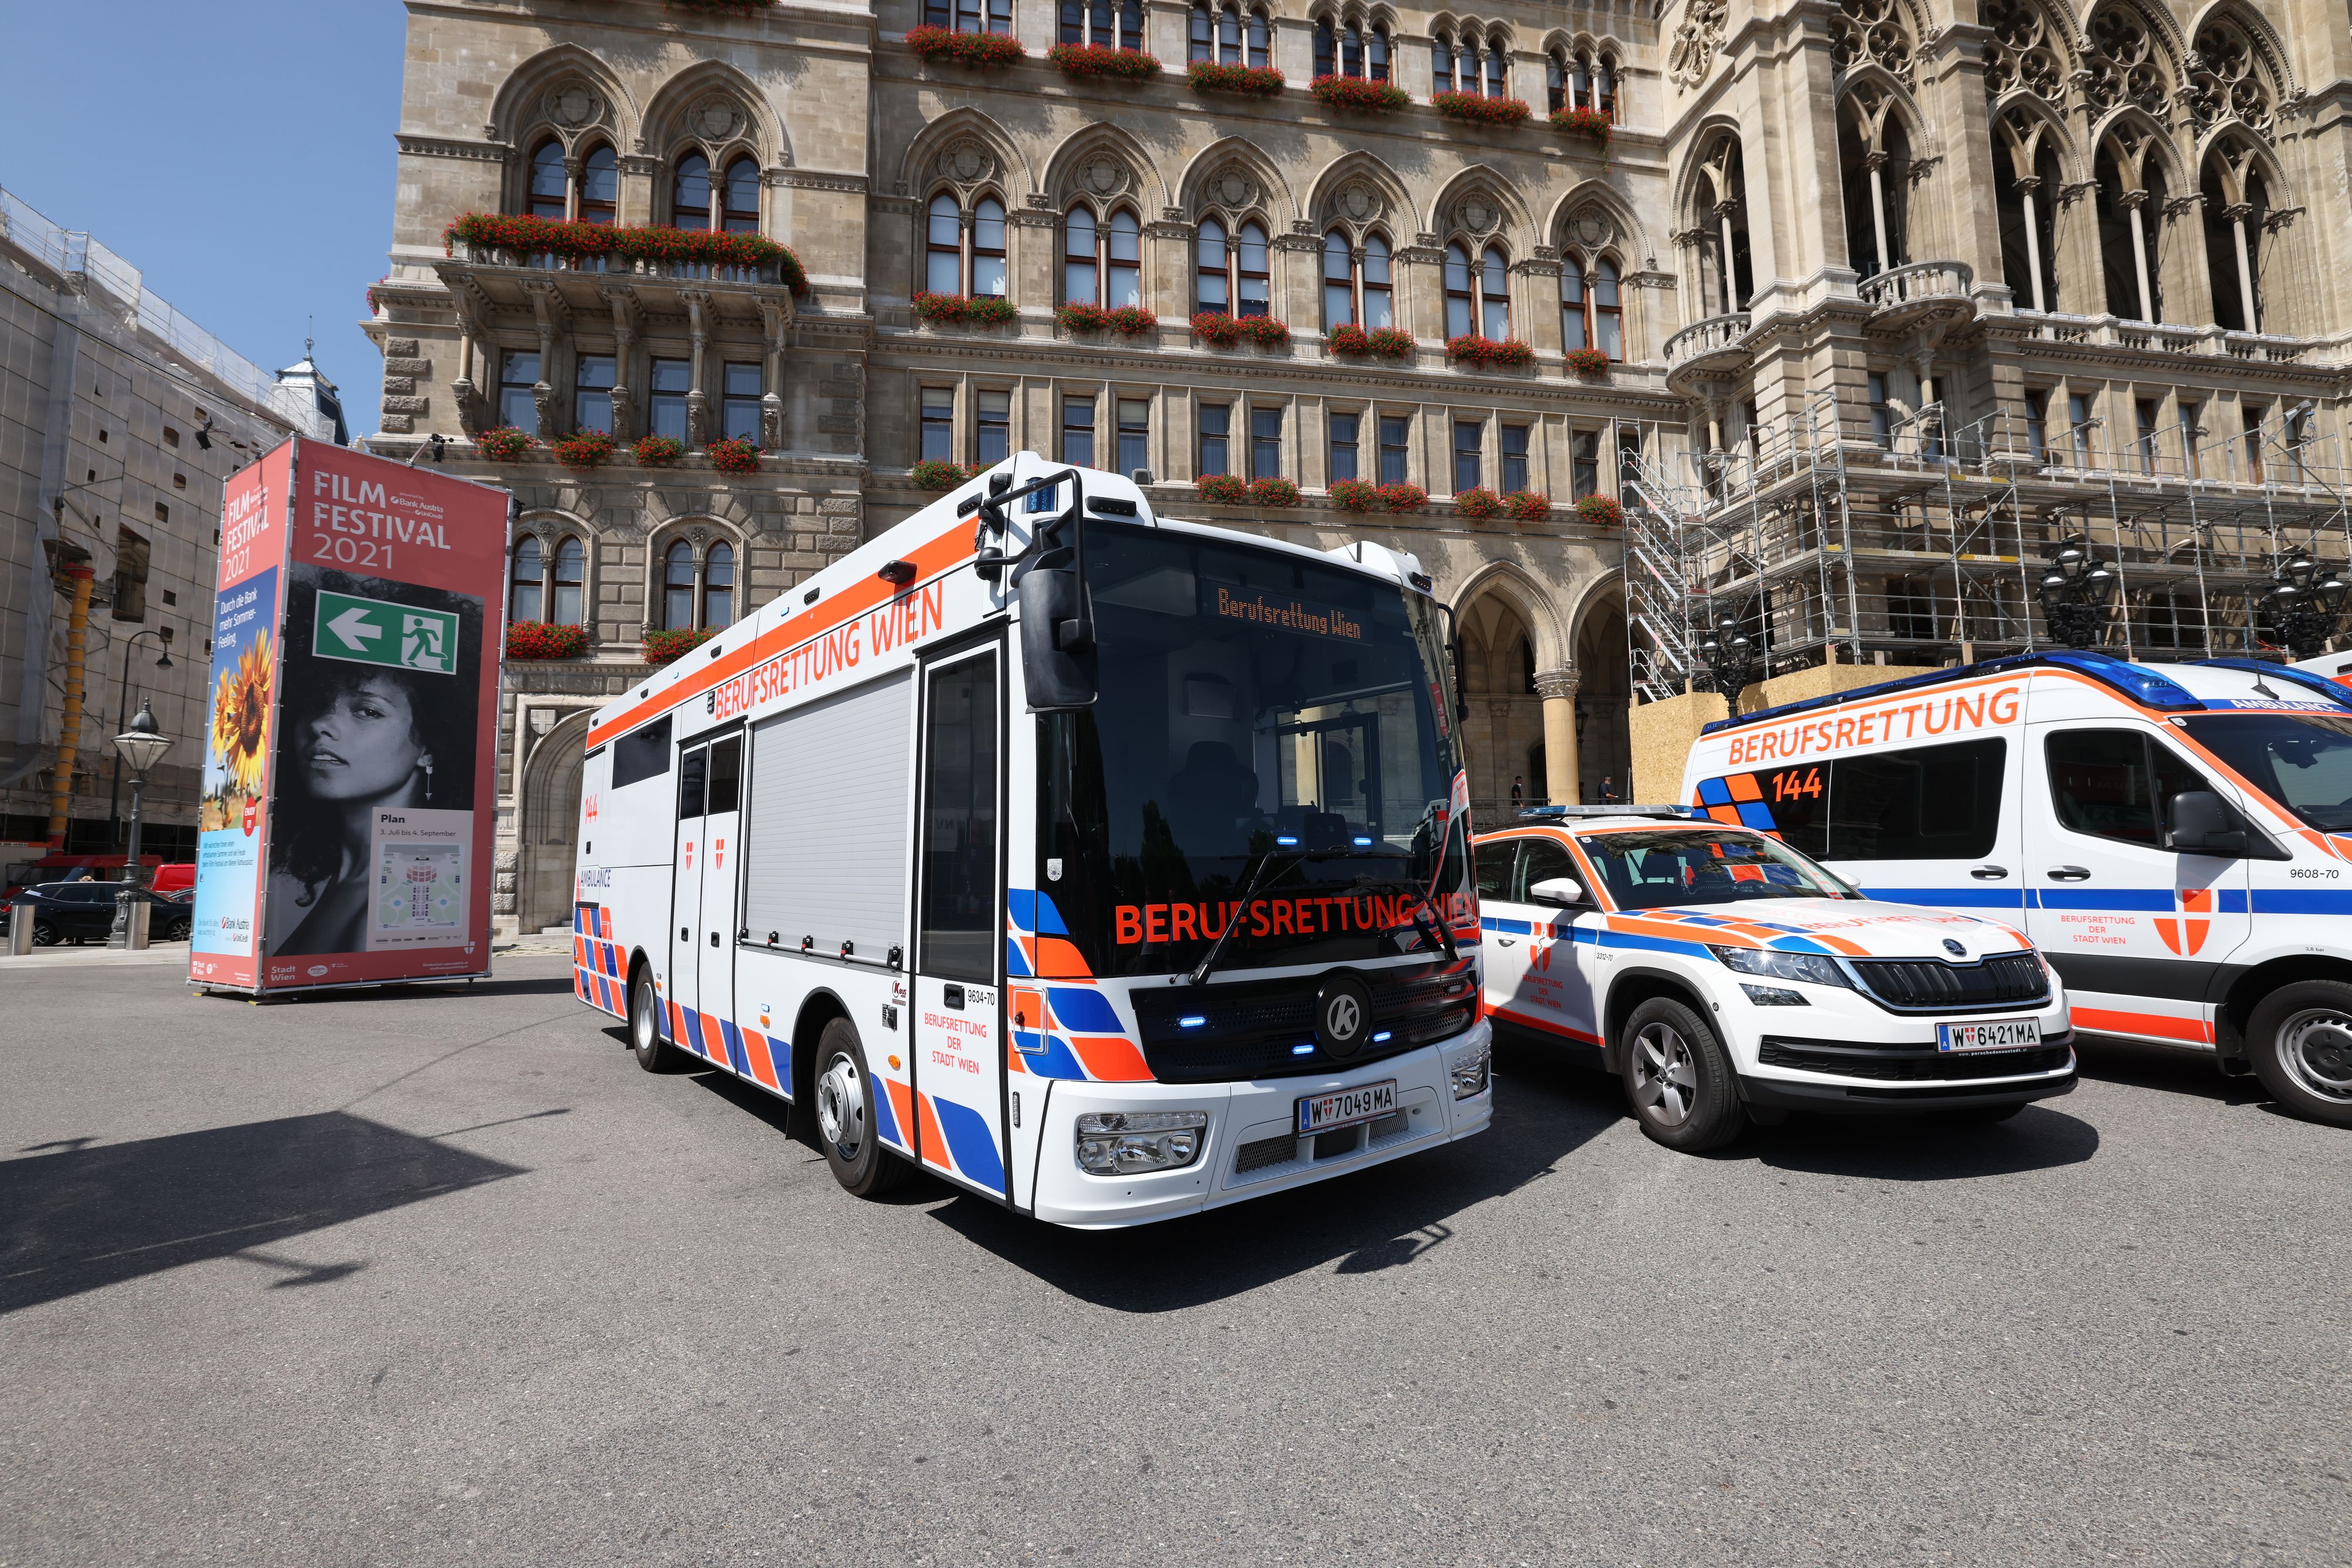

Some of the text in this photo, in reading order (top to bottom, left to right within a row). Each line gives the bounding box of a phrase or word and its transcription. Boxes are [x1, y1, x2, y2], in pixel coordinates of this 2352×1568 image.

[315, 470, 386, 509] FILM
[228, 490, 250, 526] FILM
[400, 498, 443, 513] Bank Austria
[421, 511, 443, 520] UniCredit
[226, 506, 269, 554] FESTIVAL
[314, 502, 451, 550] FESTIVAL
[313, 533, 392, 569] 2021
[225, 546, 250, 583] 2021
[1726, 576, 1746, 590] XERVON
[220, 599, 235, 615] Durch
[245, 587, 258, 603] Bank
[1218, 588, 1361, 638] Berufsrettung Wien
[219, 617, 232, 632] mehr
[716, 580, 943, 721] BERUFSRETTUNG WIEN
[2230, 700, 2341, 713] AMBULANCE
[1728, 687, 2020, 765] BERUFSRETTUNG
[1772, 767, 1822, 803] 144
[381, 814, 405, 824] Plan
[585, 794, 597, 825] 144
[580, 869, 611, 888] AMBULANCE
[2290, 869, 2339, 878] 9608-70
[226, 917, 249, 930] Bank Austria
[1115, 894, 1414, 944] BERUFSRETTUNG
[1798, 915, 1975, 931] BERUFSRETTUNG
[2061, 915, 2136, 925] BERUFSRETTUNG
[2073, 935, 2099, 943] STADT
[1596, 952, 1613, 961] 3312-70
[271, 965, 296, 974] Stadt
[1522, 974, 1563, 989] BERUFSRETTUNG
[968, 989, 995, 1005] 9634-70
[1530, 995, 1561, 1009] STADT WIEN
[924, 1012, 987, 1038] BERUFSRETTUNG
[947, 1036, 961, 1051] DER
[1952, 1028, 1964, 1047] W
[932, 1051, 980, 1075] STADT WIEN
[1312, 1101, 1322, 1124] W
[1335, 1092, 1371, 1119] 7049
[1374, 1087, 1392, 1110] MA
